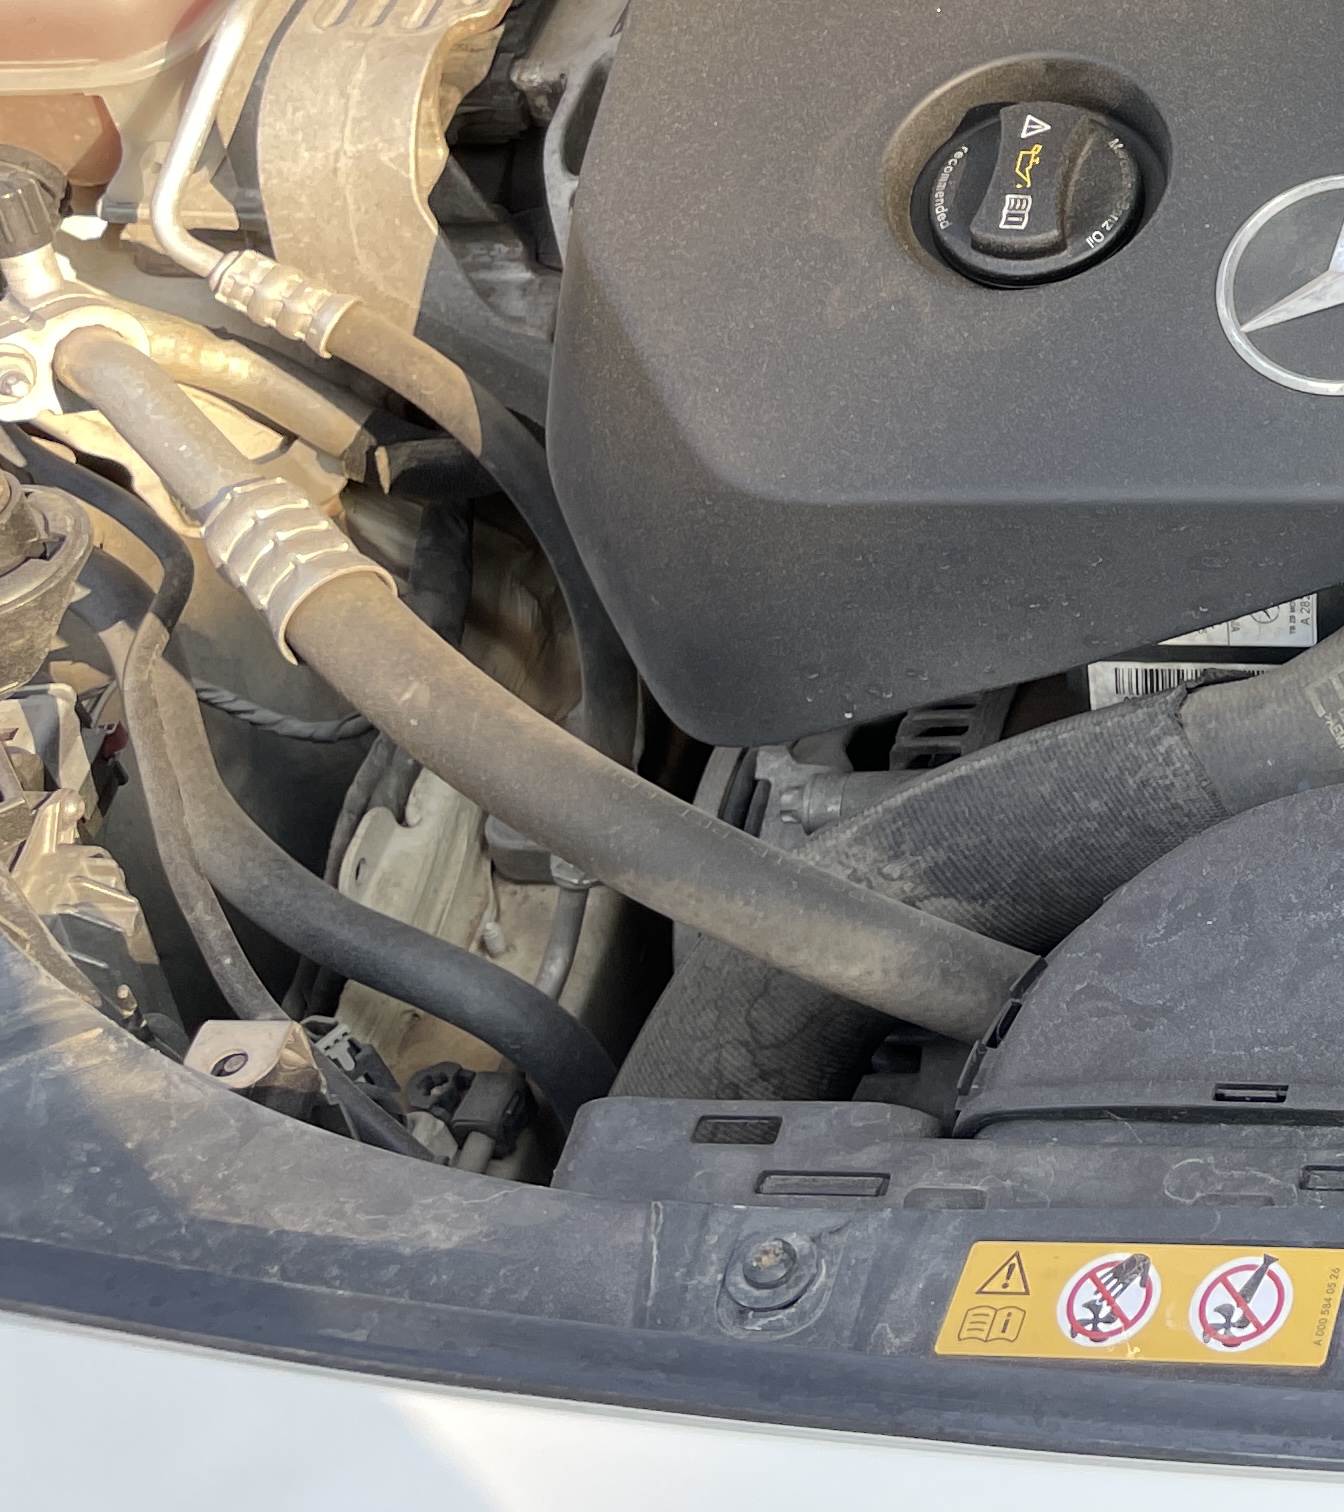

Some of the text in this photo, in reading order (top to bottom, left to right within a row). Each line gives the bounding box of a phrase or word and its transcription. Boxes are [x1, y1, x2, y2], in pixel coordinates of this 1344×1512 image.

[933, 144, 970, 230] recommended
[1085, 230, 1105, 249] Oil
[1300, 617, 1311, 626] A
[1329, 1267, 1341, 1280] 26
[1326, 1282, 1337, 1295] 05
[1315, 1318, 1328, 1337] 000
[1313, 1339, 1323, 1347] A
